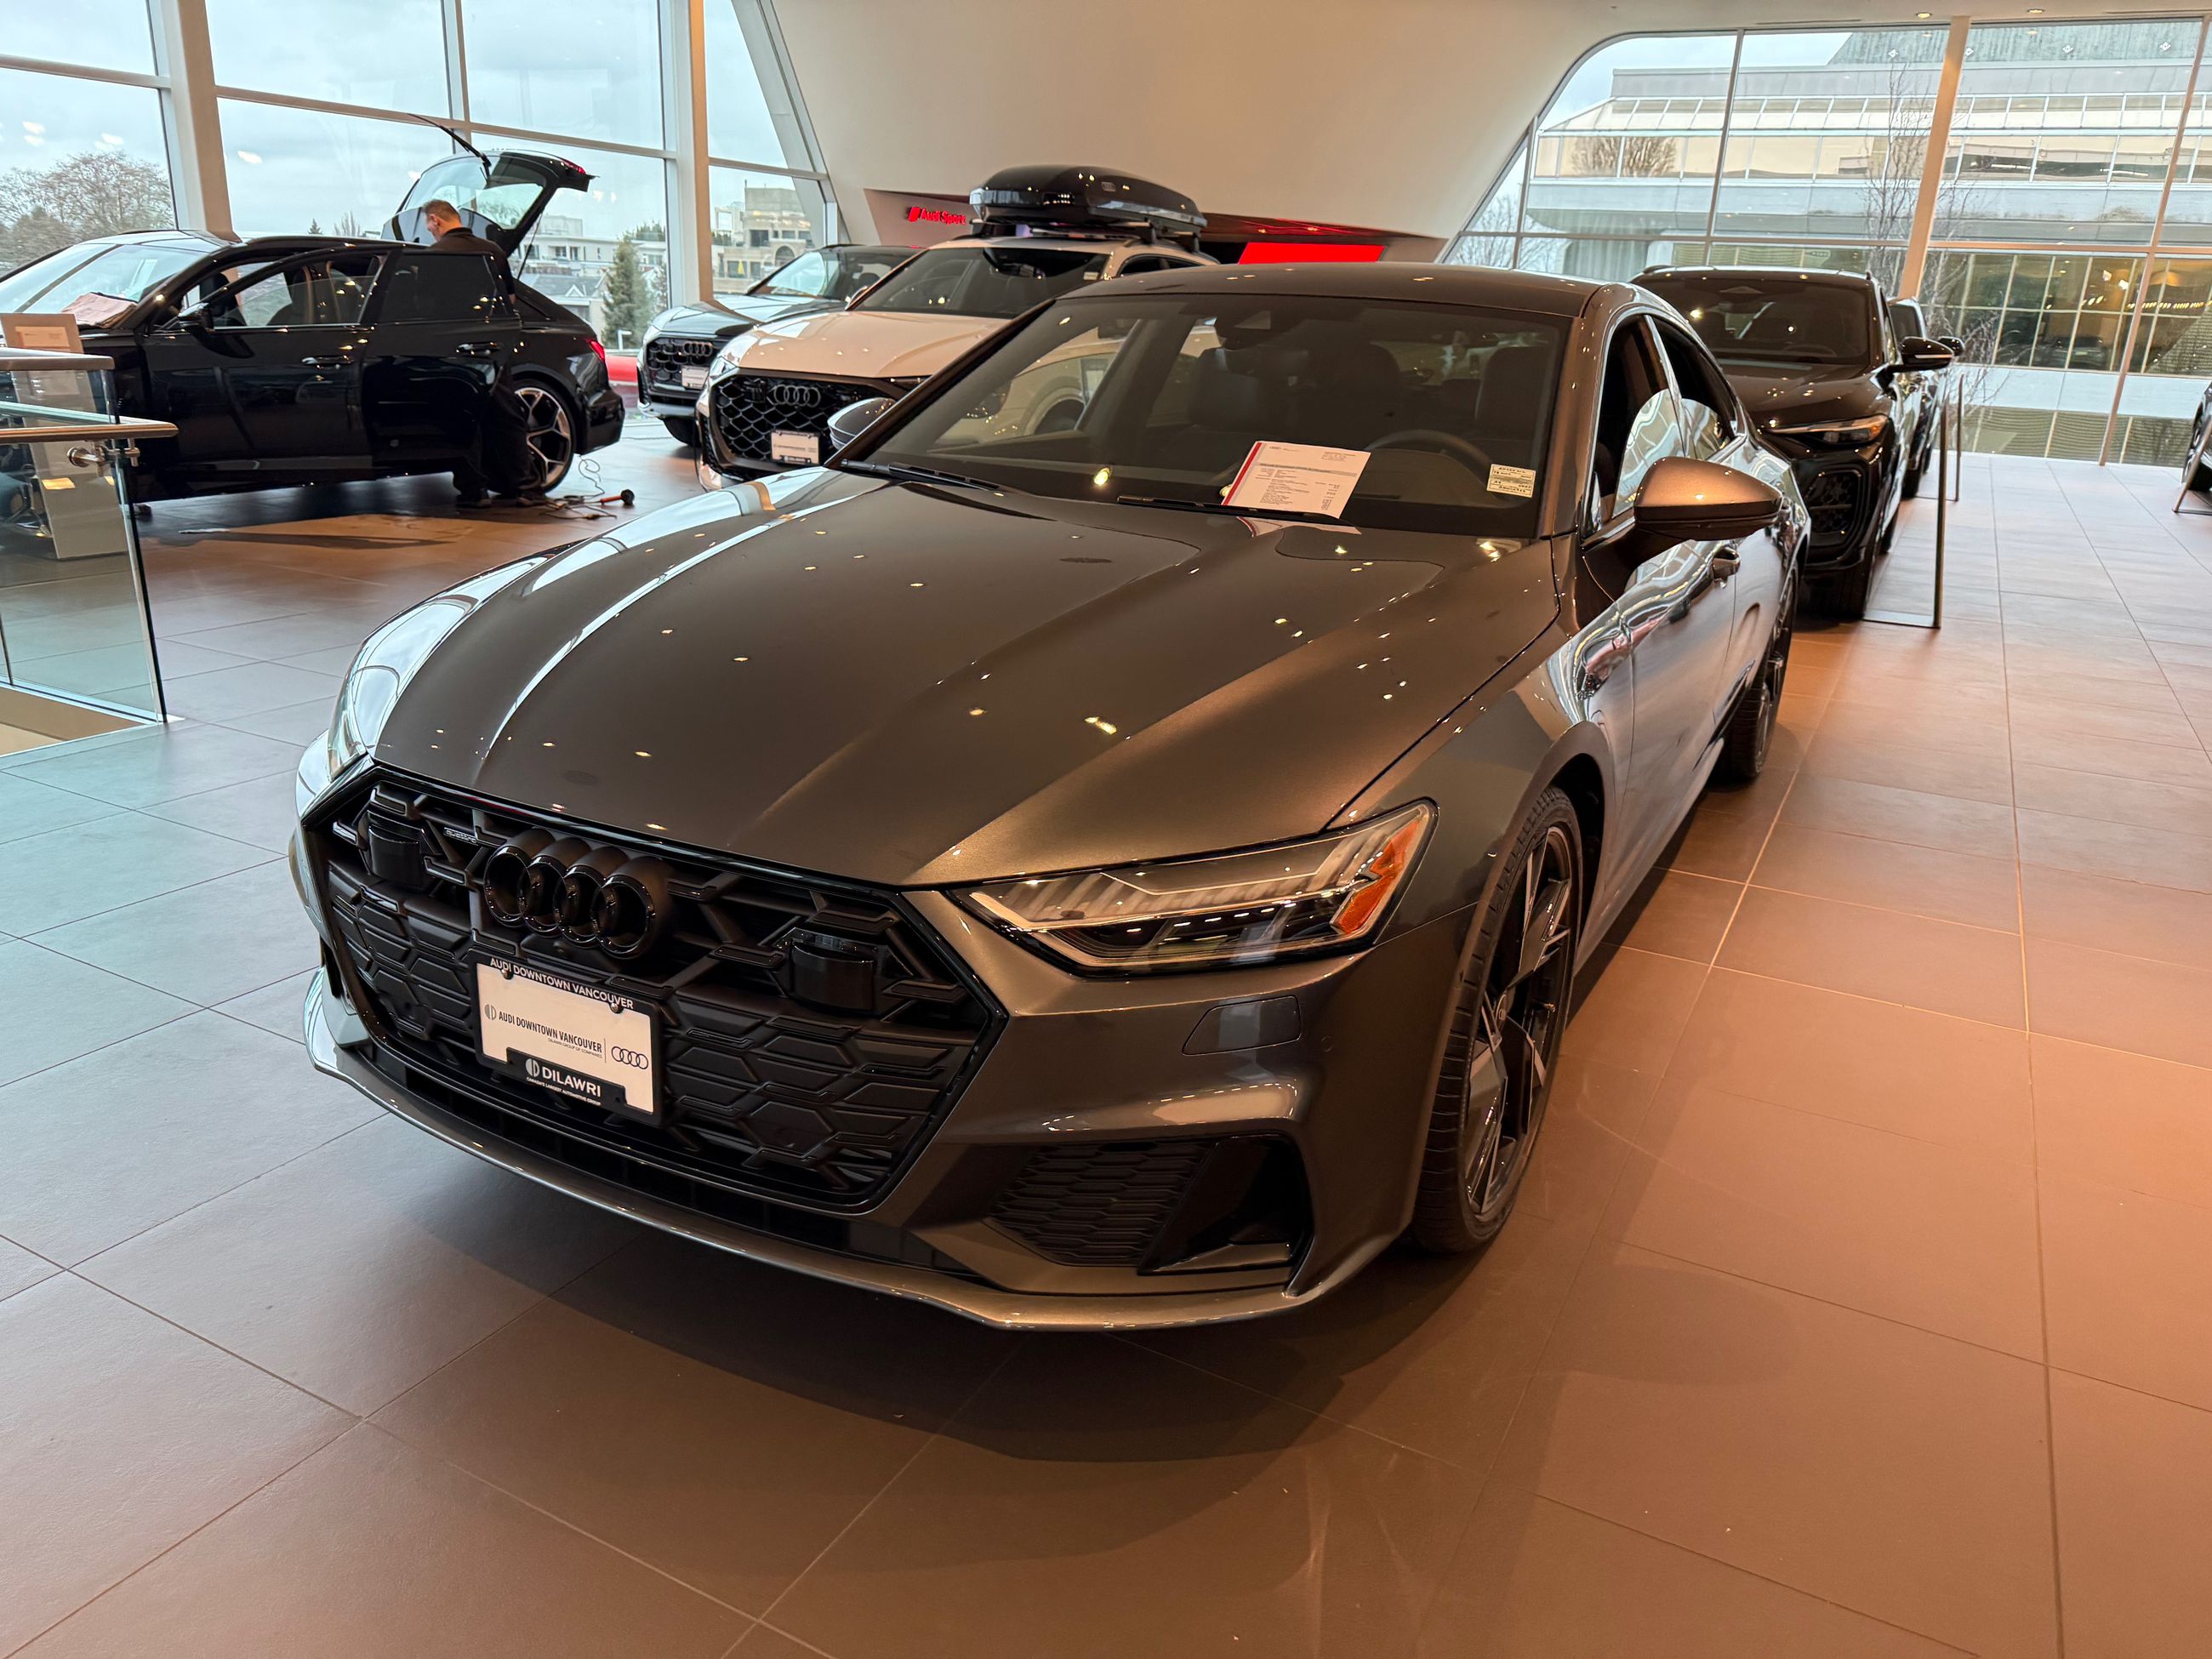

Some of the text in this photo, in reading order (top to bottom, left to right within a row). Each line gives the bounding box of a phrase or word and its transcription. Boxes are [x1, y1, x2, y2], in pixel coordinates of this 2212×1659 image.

[921, 208, 966, 225] Audi Sport
[490, 958, 633, 1009] AUDI DOWNTOWN VANCOUVER
[499, 1011, 602, 1053] AUDI DOWNTOWN VANCOUVER
[542, 1066, 601, 1097] DILAWRI
